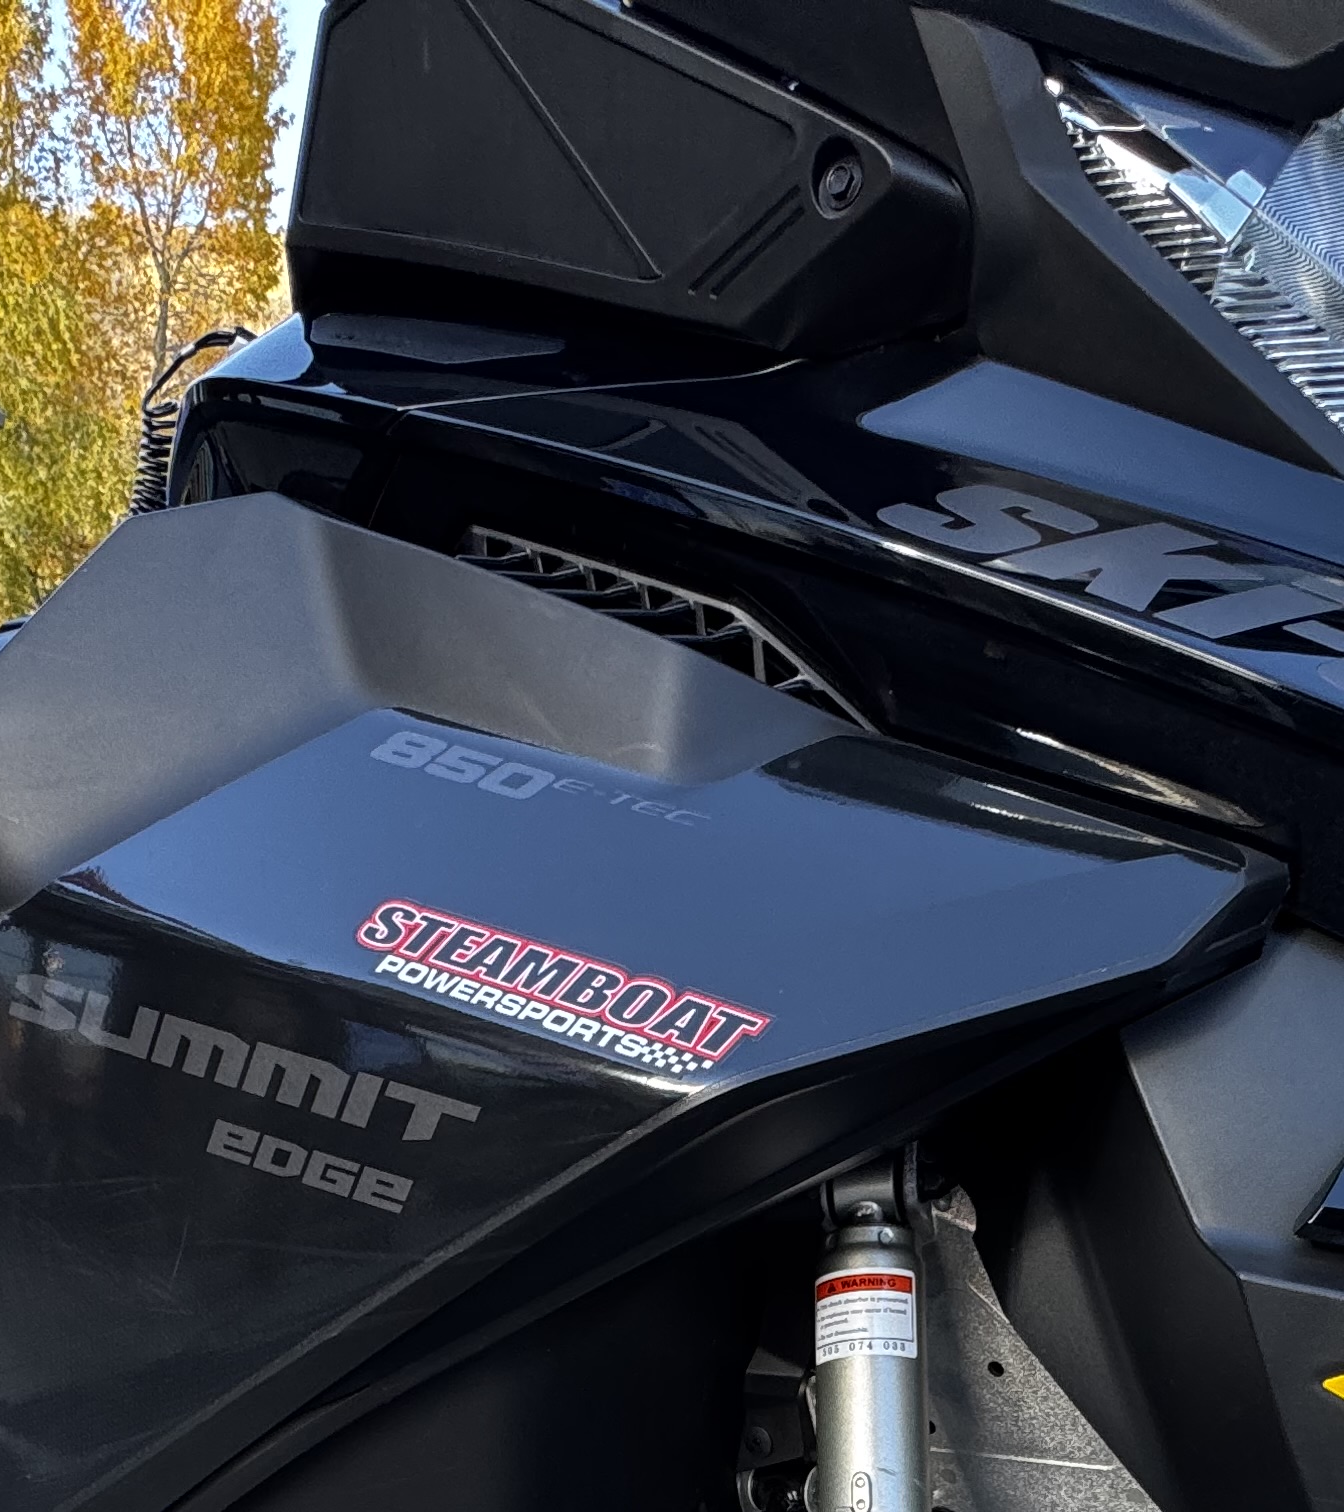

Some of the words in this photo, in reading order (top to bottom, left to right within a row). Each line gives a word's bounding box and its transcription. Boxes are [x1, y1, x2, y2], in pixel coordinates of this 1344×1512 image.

[370, 731, 556, 800] 850
[553, 779, 711, 826] E-TEC
[359, 902, 764, 1058] STEAMBOAT
[375, 955, 643, 1060] POWERSPORTS
[9, 973, 482, 1142] SUMMIT
[841, 1278, 896, 1290] WARNING
[849, 1341, 873, 1351] 074
